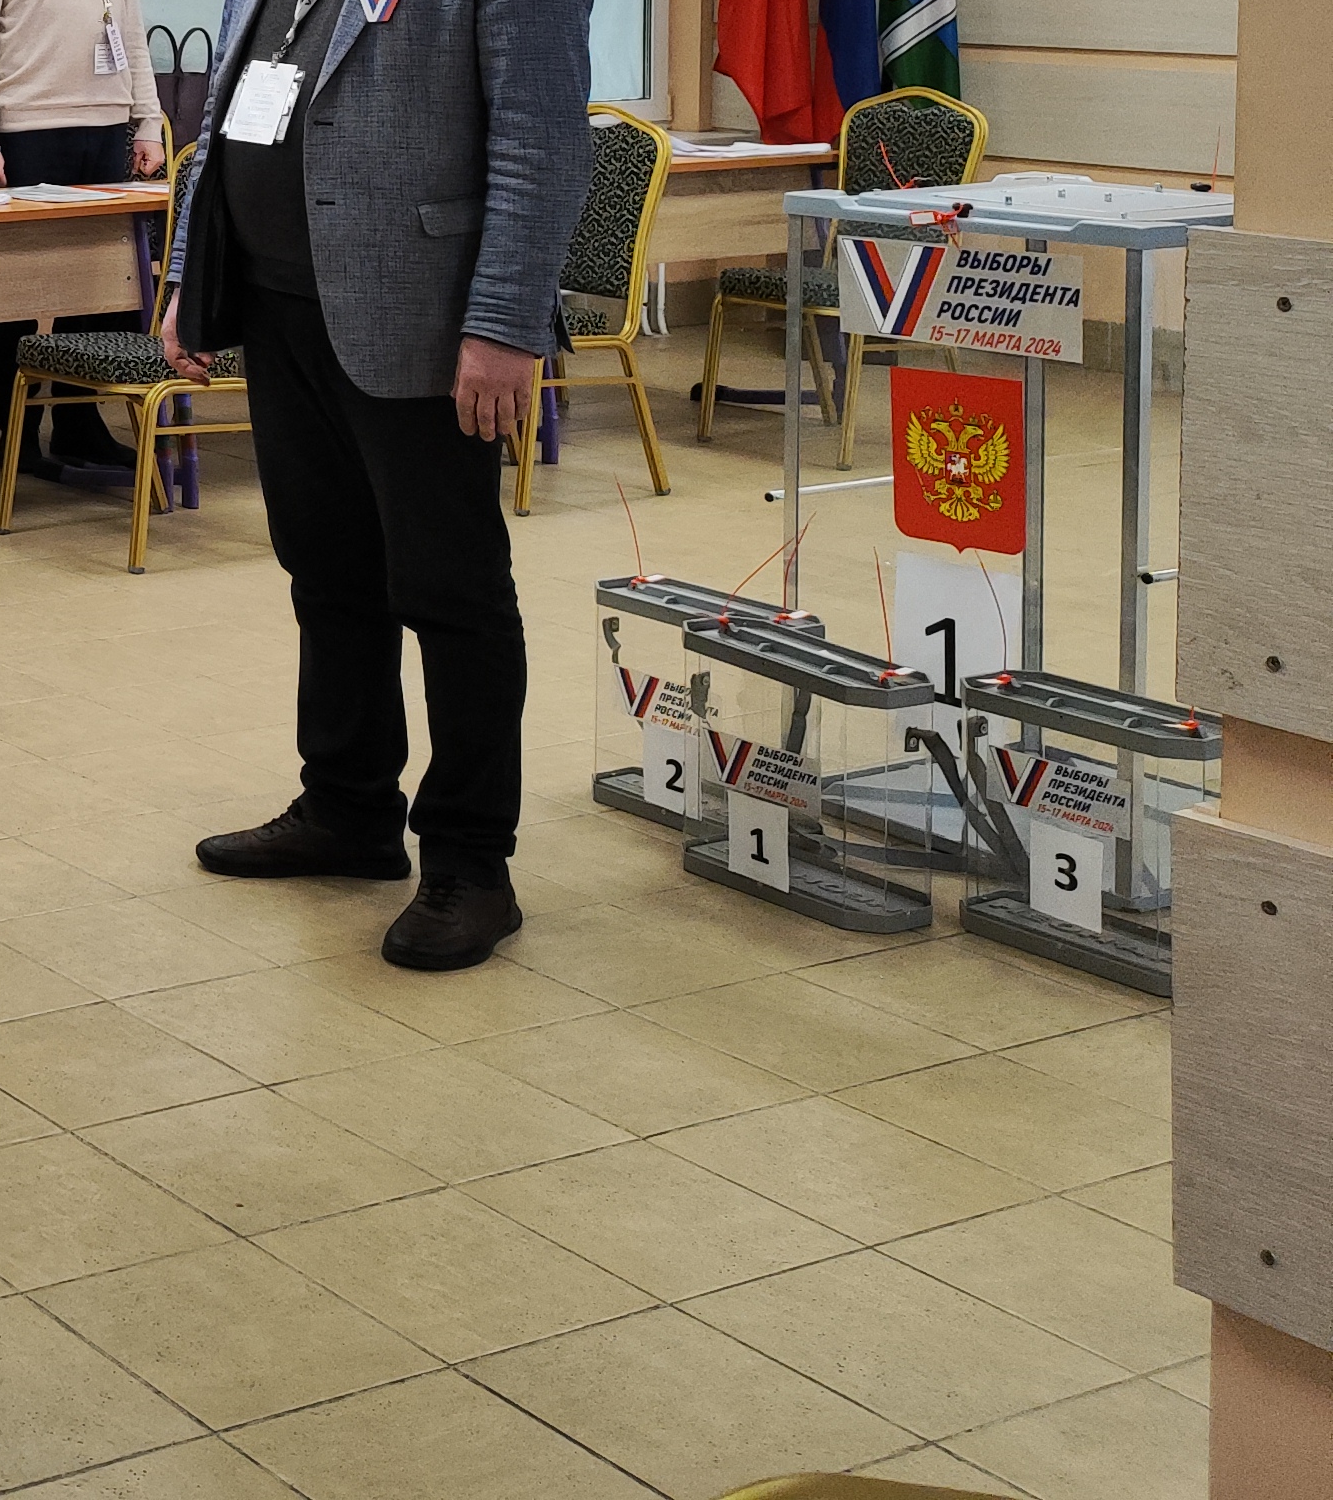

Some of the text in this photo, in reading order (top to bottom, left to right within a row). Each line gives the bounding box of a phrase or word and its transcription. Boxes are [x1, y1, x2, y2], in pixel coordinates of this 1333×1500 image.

[955, 249, 1053, 276] ВЫБОРЫ
[945, 275, 1082, 308] ПРЕЗИДЕНТА
[936, 300, 1023, 328] РОССИИ
[970, 330, 1023, 352] МАРТА
[1024, 337, 1062, 357] 2024
[924, 617, 962, 706] 1
[757, 745, 804, 767] ВЫБОРЫ
[665, 758, 685, 793] 2
[746, 770, 789, 791] РОССИИ
[751, 758, 819, 787] ПРЕЗИДЕНТА
[1054, 765, 1110, 789] ВЫБОРЫ
[763, 787, 789, 805] МАРТА
[1041, 791, 1092, 813] РОССИИ
[1047, 778, 1127, 809] ПРЕЗИДЕНТА
[1061, 811, 1091, 826] МАРТА
[1092, 820, 1115, 833] 2024
[749, 827, 770, 865] 1
[1053, 852, 1079, 892] 3
